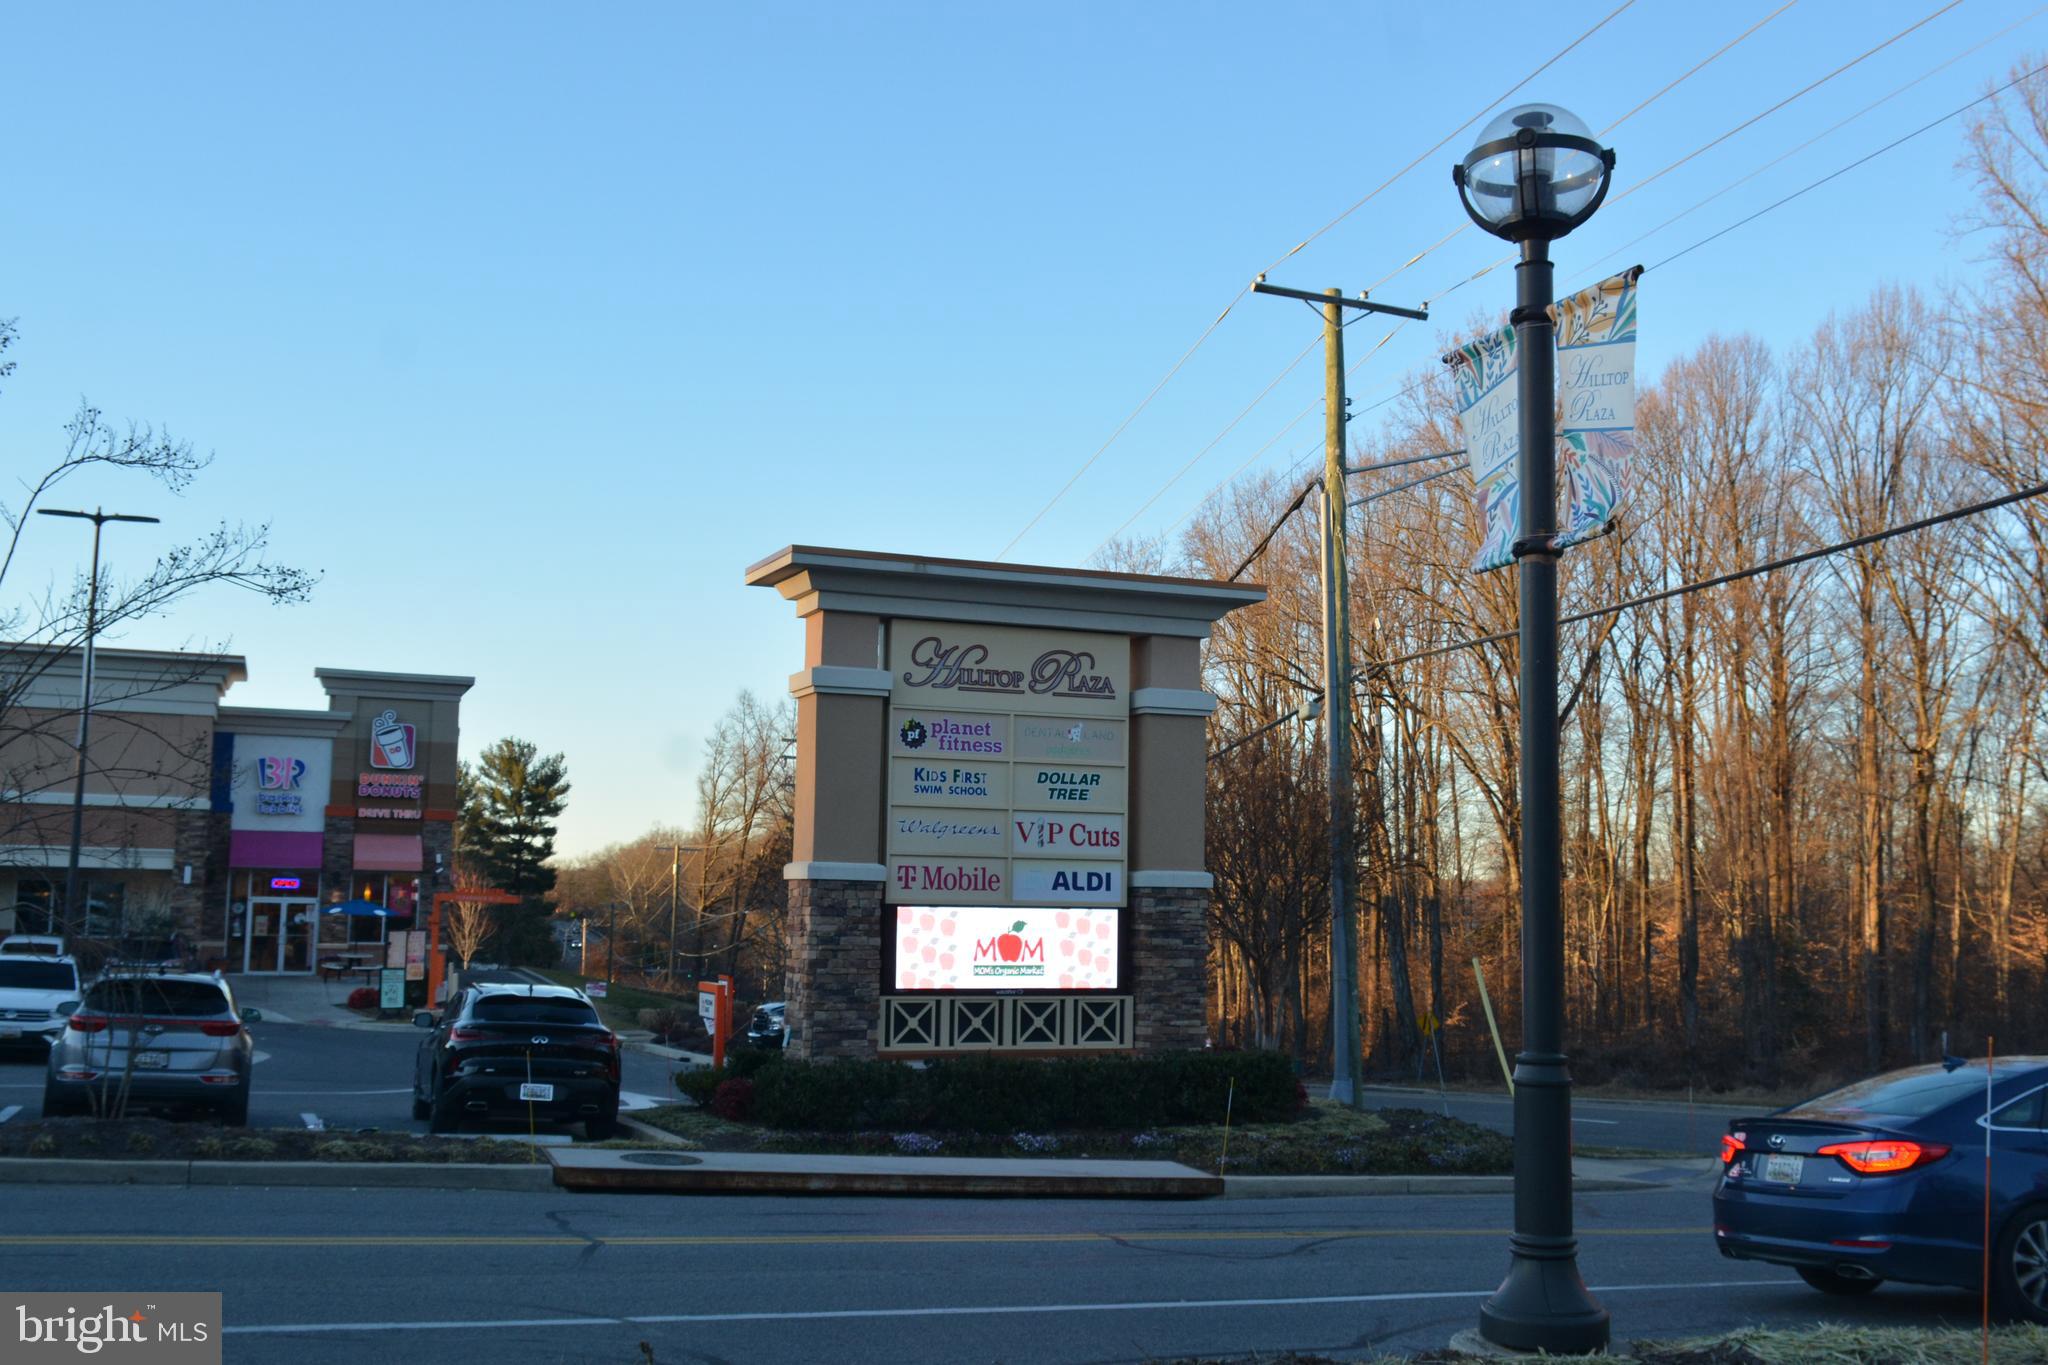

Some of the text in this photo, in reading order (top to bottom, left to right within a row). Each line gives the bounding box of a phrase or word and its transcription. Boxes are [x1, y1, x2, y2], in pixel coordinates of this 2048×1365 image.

[1566, 354, 1629, 390] HILLTOP
[1570, 391, 1616, 422] PLAZA
[1472, 395, 1518, 441] HILLTO
[904, 637, 1115, 695] HILLTOP PLAZA
[930, 719, 991, 738] planet
[939, 735, 1002, 753] fitness
[258, 756, 305, 789] BR
[914, 767, 987, 783] KIDS FIRST
[1037, 772, 1100, 786] DOLLAR
[358, 785, 420, 798] DONUTS
[914, 785, 988, 796] SWIM SCHOOL
[1049, 788, 1089, 801] TREE
[358, 808, 421, 819] DRIVE THRU
[897, 820, 1000, 839] Walgreens
[1069, 824, 1120, 847] Cuts
[923, 866, 1001, 891] Mobile
[1051, 871, 1111, 891] ALDI
